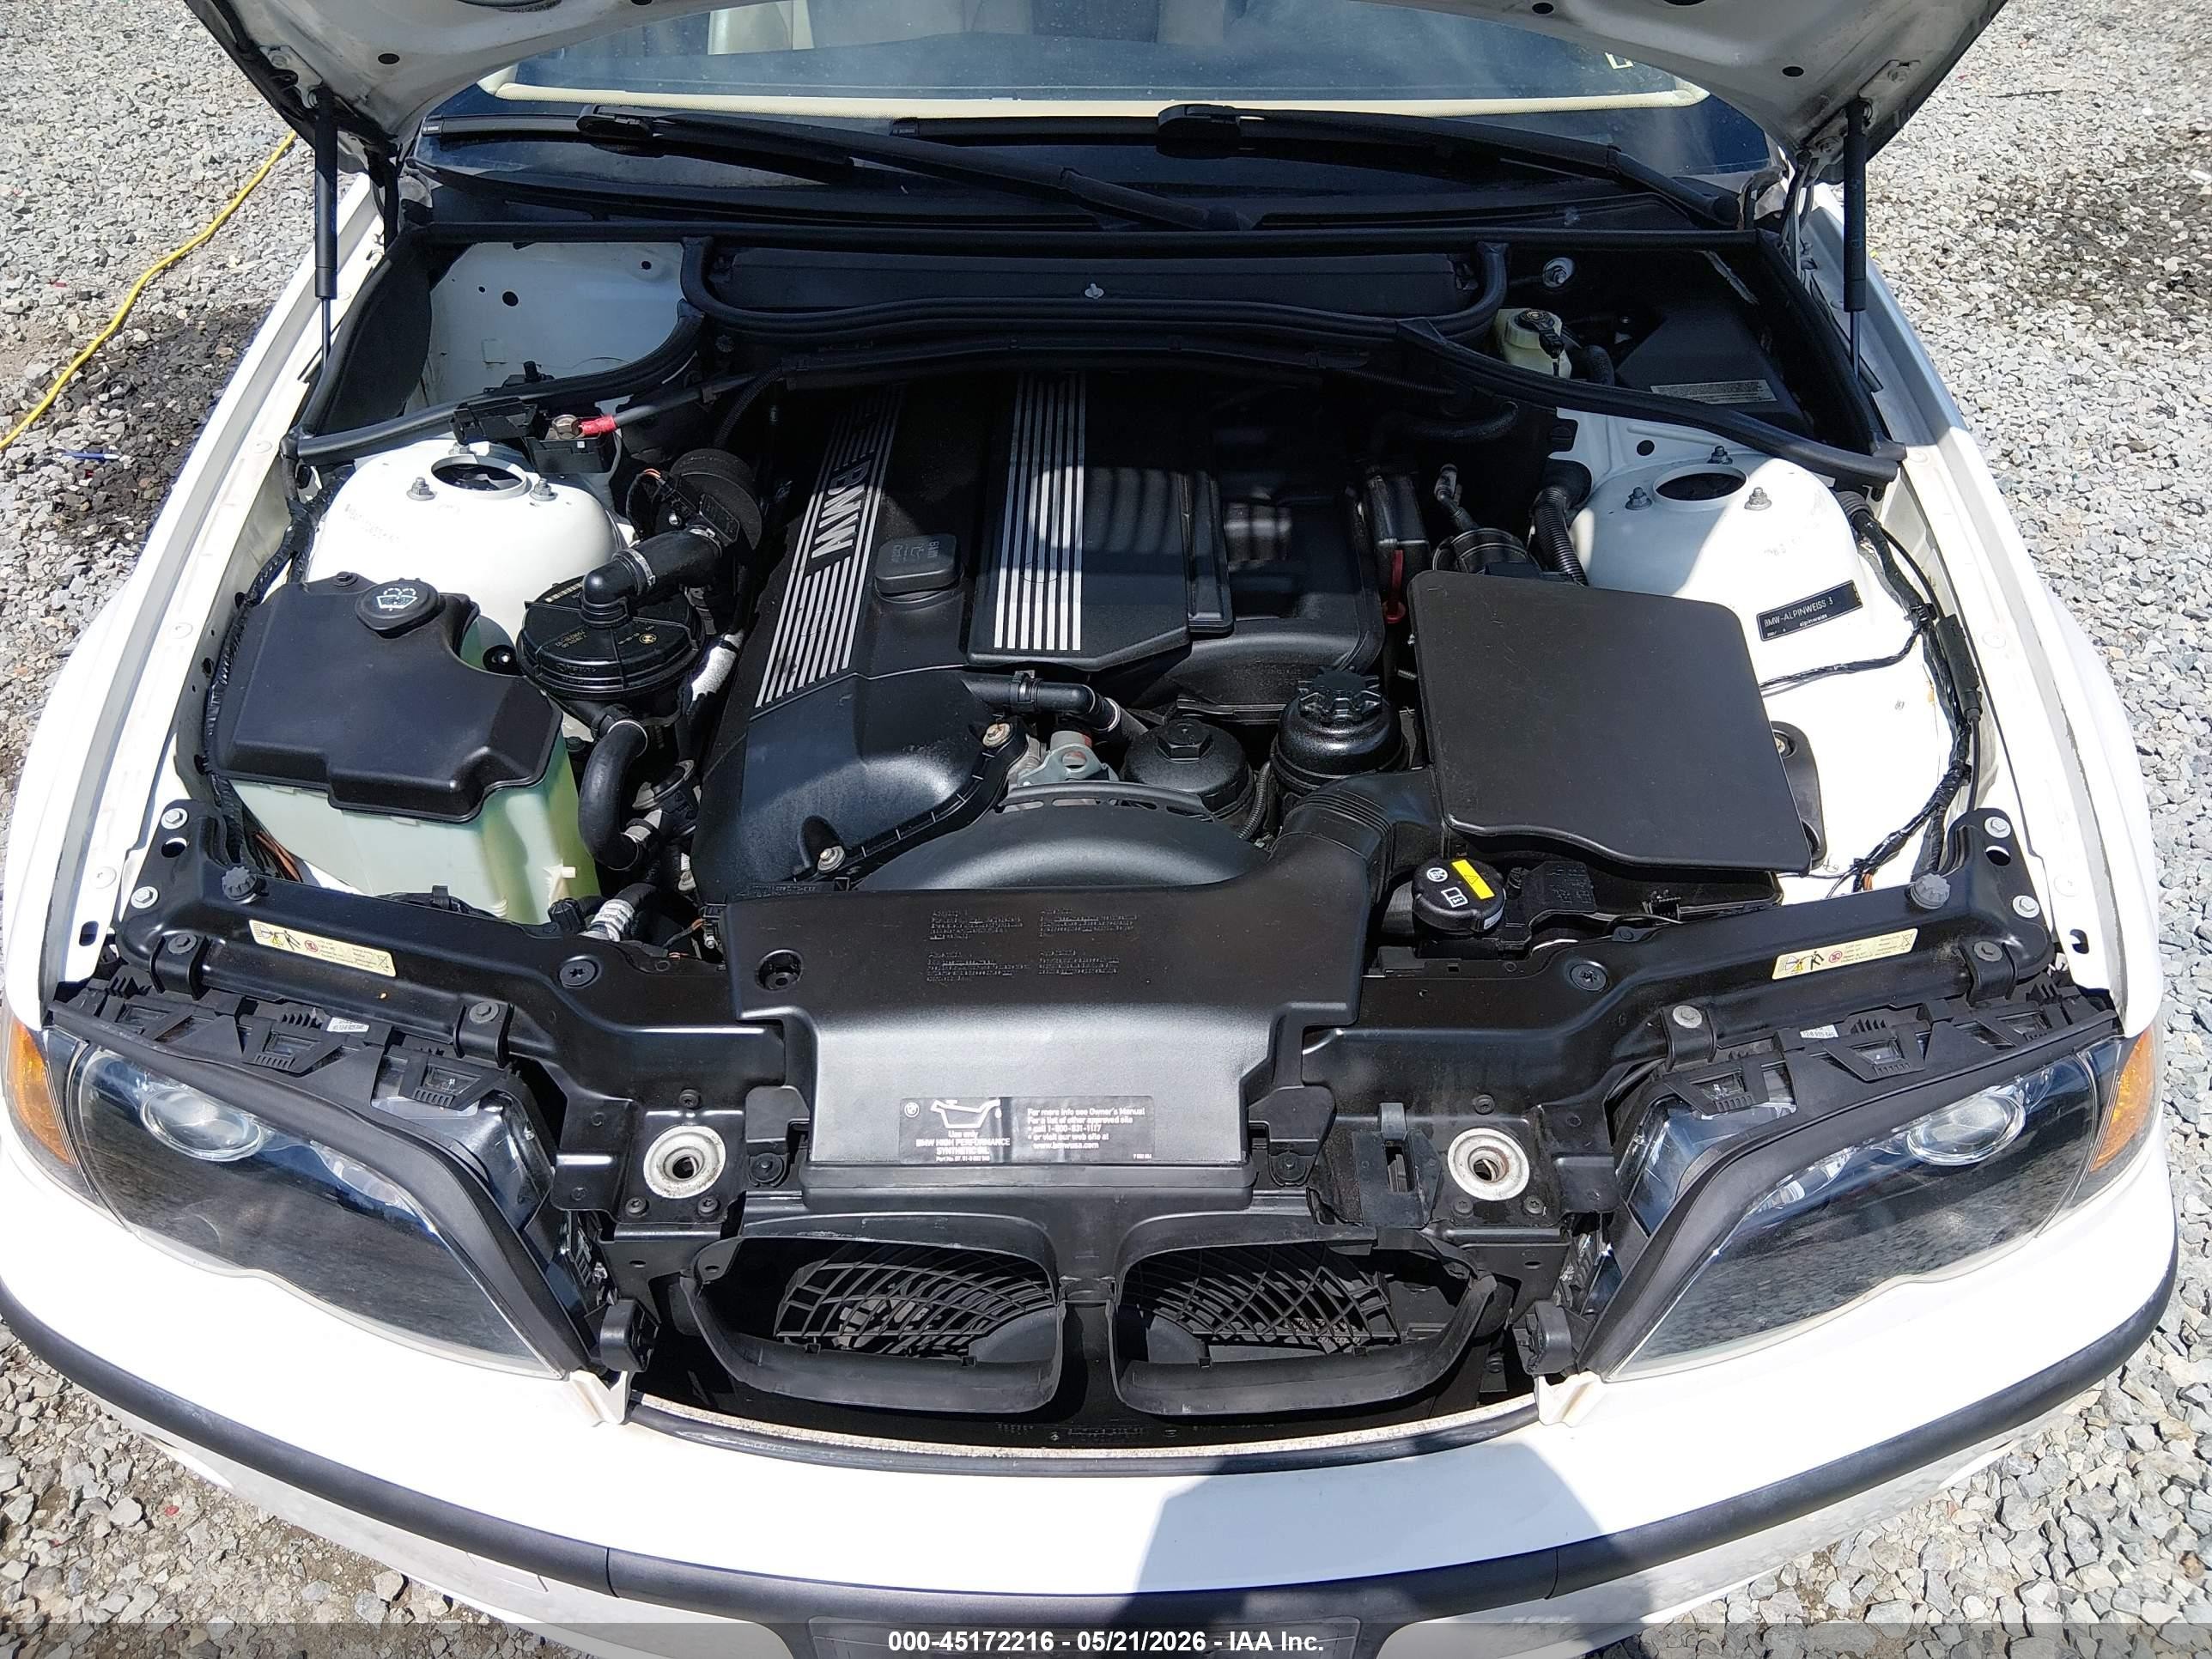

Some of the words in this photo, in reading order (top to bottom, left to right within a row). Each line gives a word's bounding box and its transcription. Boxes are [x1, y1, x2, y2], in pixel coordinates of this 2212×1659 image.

[811, 459, 872, 559] BMW
[1764, 599, 1826, 628] BMW-ALPINWEISS
[1119, 1107, 1146, 1115] Manual
[915, 1139, 935, 1147] BMW
[935, 1139, 955, 1147] HIGH
[955, 1137, 1011, 1146] PERFORMANCE
